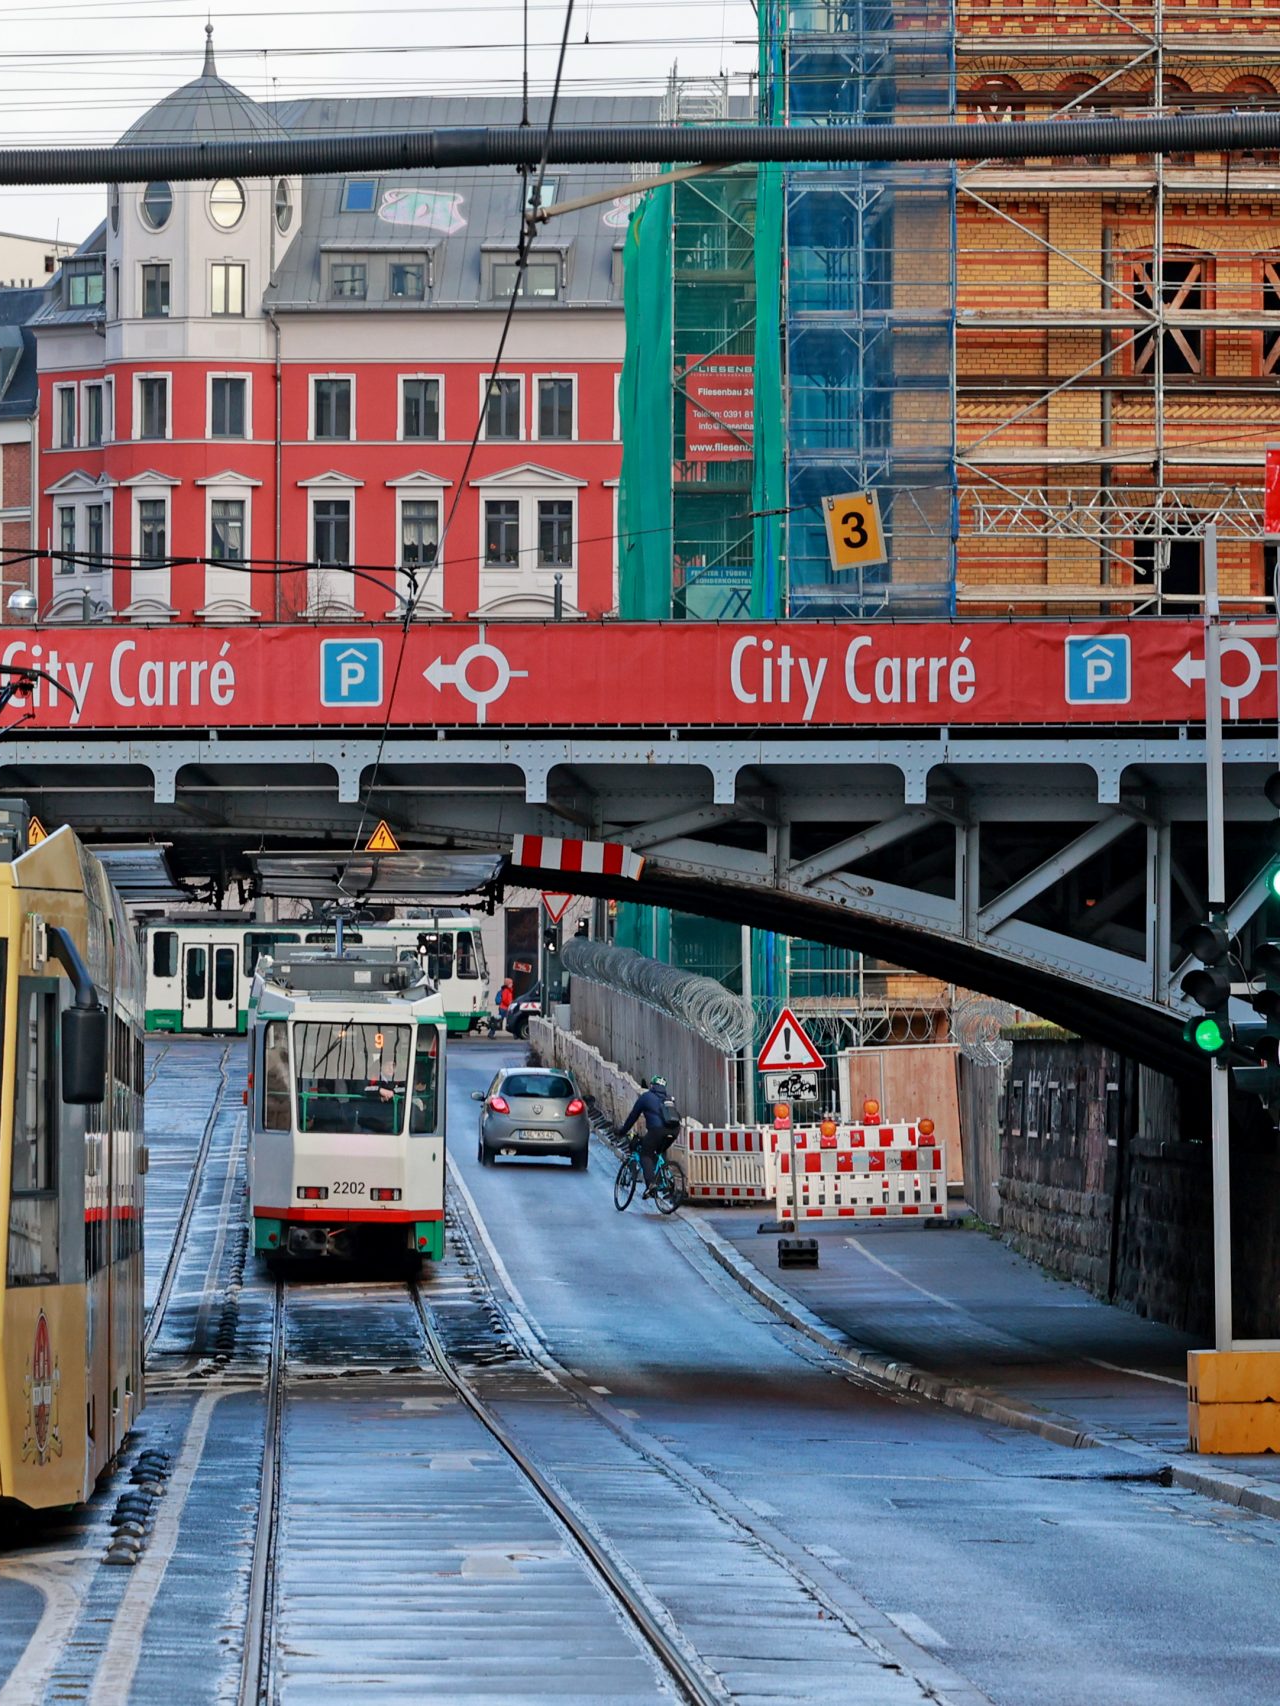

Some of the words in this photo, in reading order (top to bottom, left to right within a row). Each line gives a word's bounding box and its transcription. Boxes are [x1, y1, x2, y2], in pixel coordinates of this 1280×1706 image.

[698, 387, 742, 396] Fliesenbau
[841, 511, 868, 549] 3
[0, 641, 95, 725] City
[109, 640, 236, 707] Carré
[340, 662, 366, 697] P
[730, 635, 829, 721] City
[844, 635, 976, 704] Carré
[1086, 659, 1112, 694] P
[374, 1033, 385, 1049] 9
[333, 1181, 366, 1195] 2202
